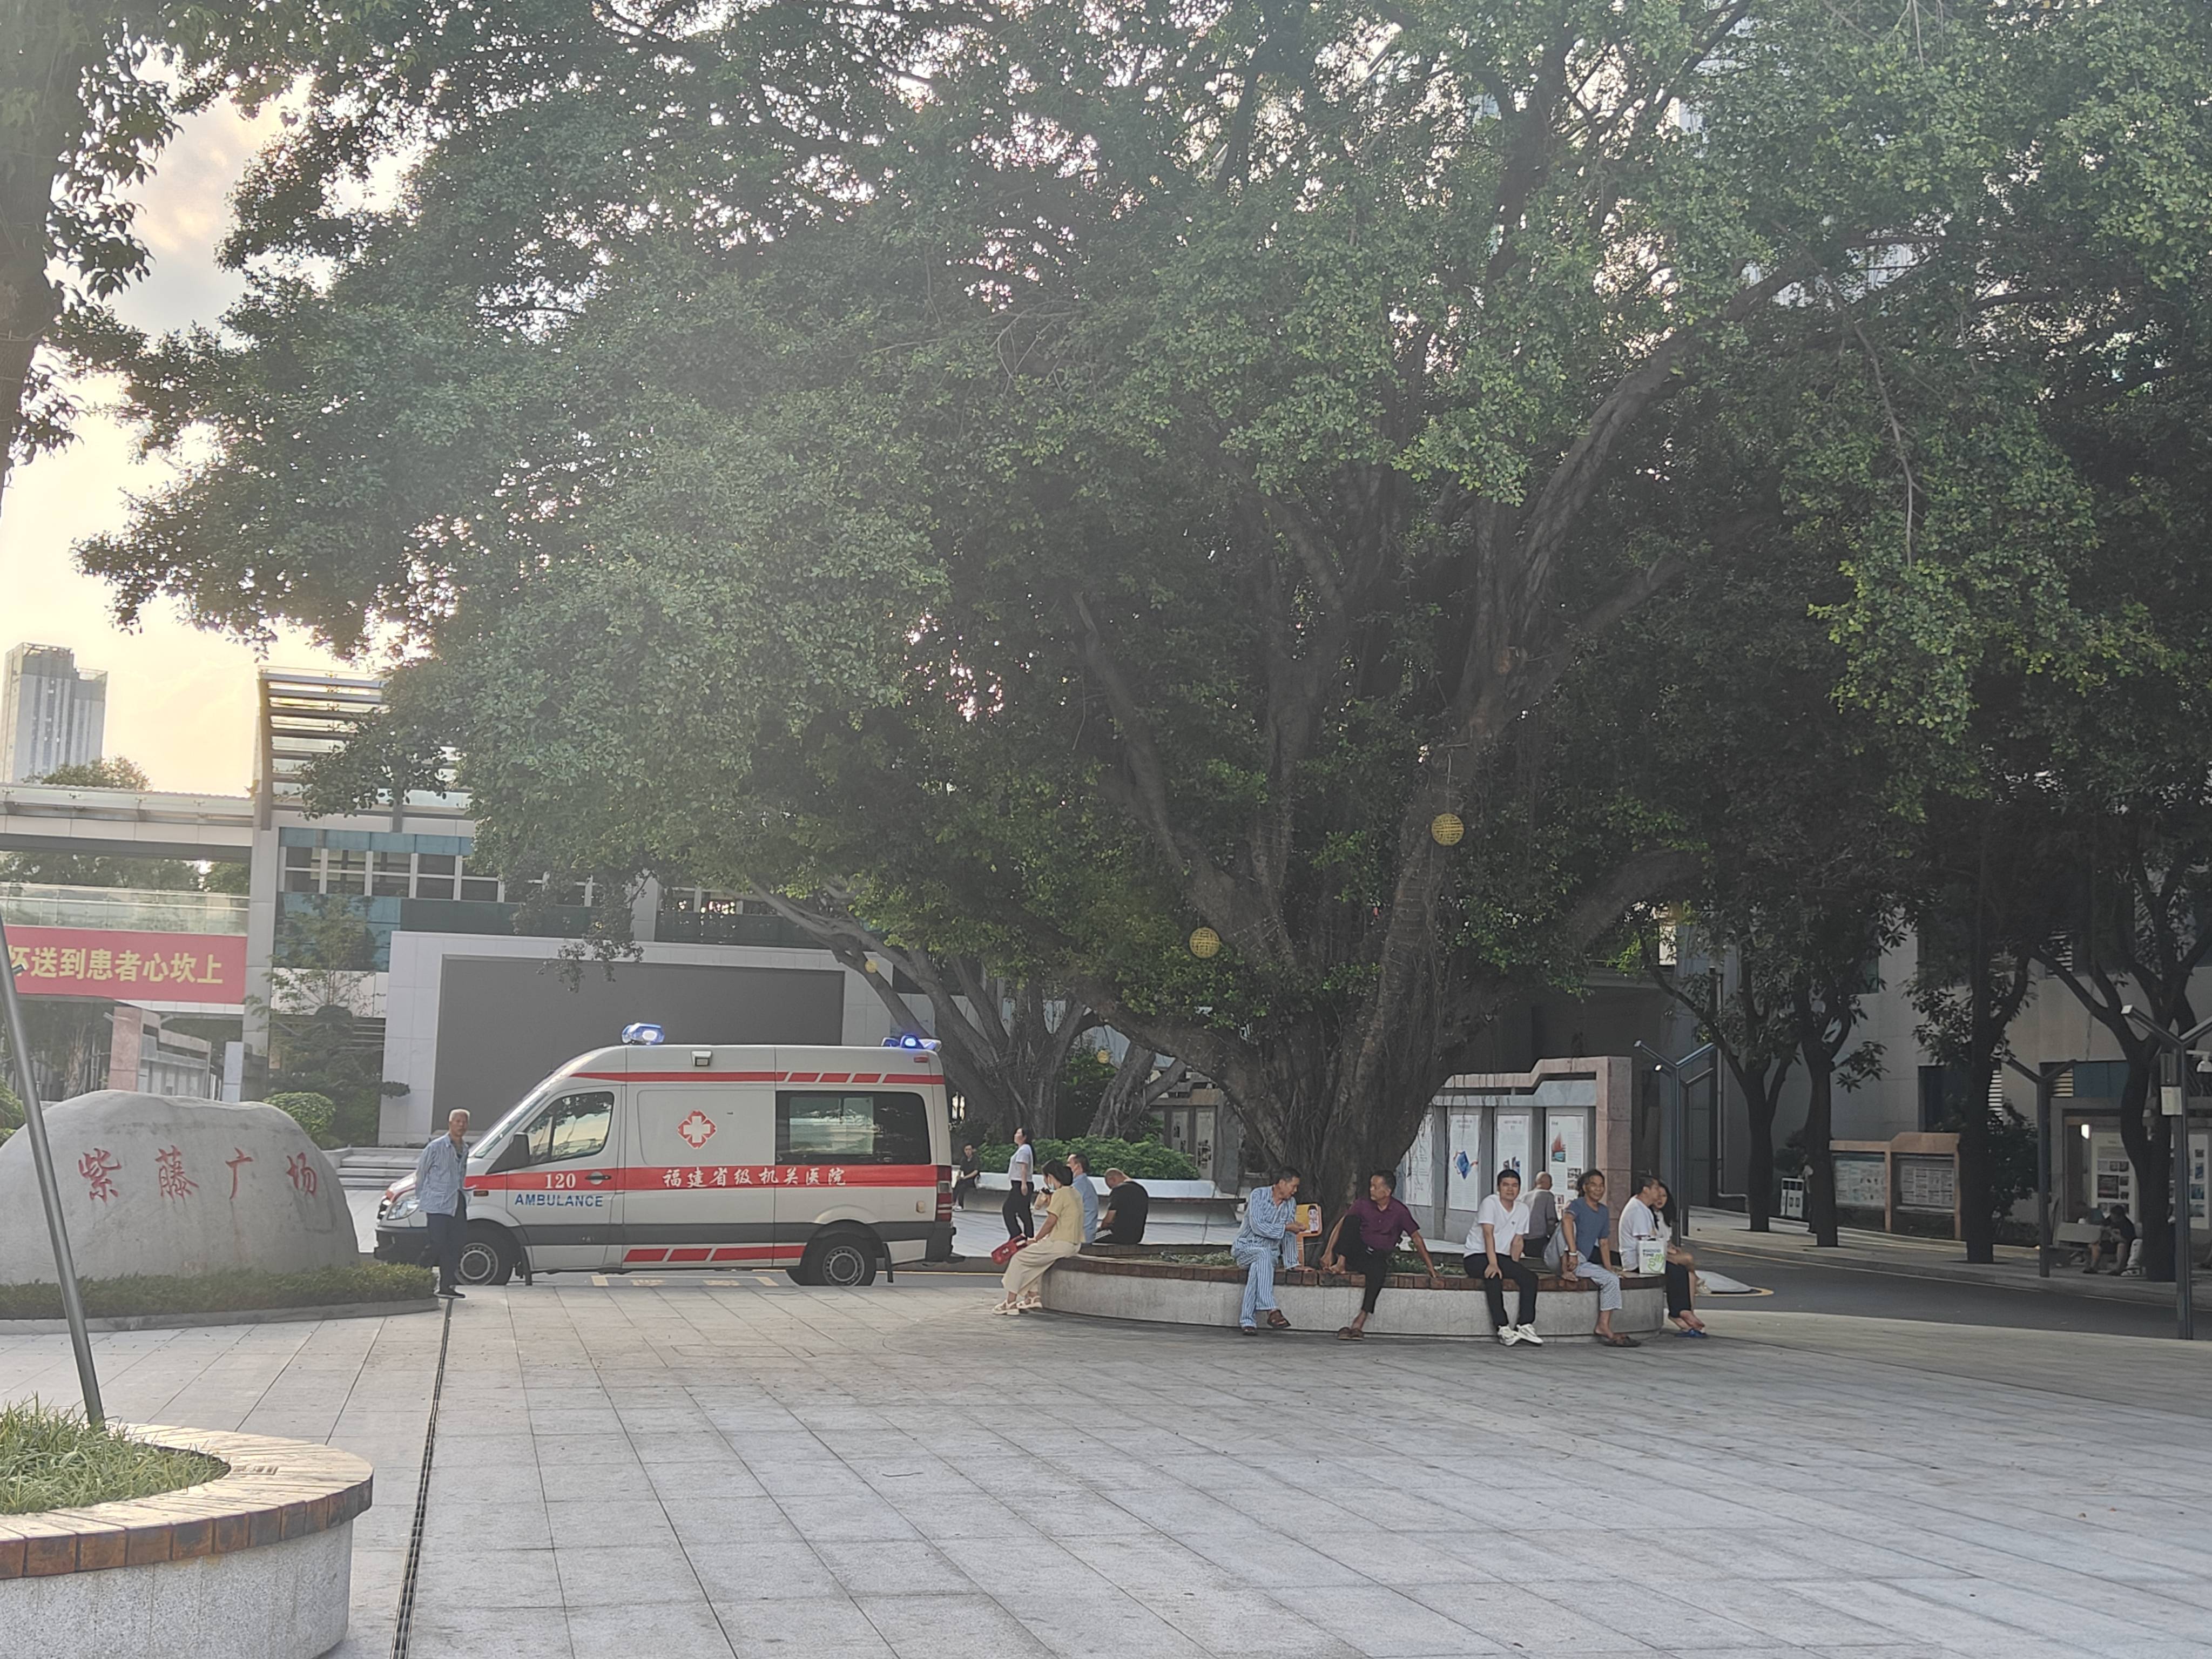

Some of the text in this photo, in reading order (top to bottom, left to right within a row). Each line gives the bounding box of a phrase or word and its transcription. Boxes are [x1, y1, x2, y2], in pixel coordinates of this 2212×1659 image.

[78, 1145, 318, 1202] 紫藤广场
[545, 1173, 576, 1189] 120
[662, 1166, 846, 1188] 福建省级机关医院
[515, 1193, 604, 1207] AMBULANCE
